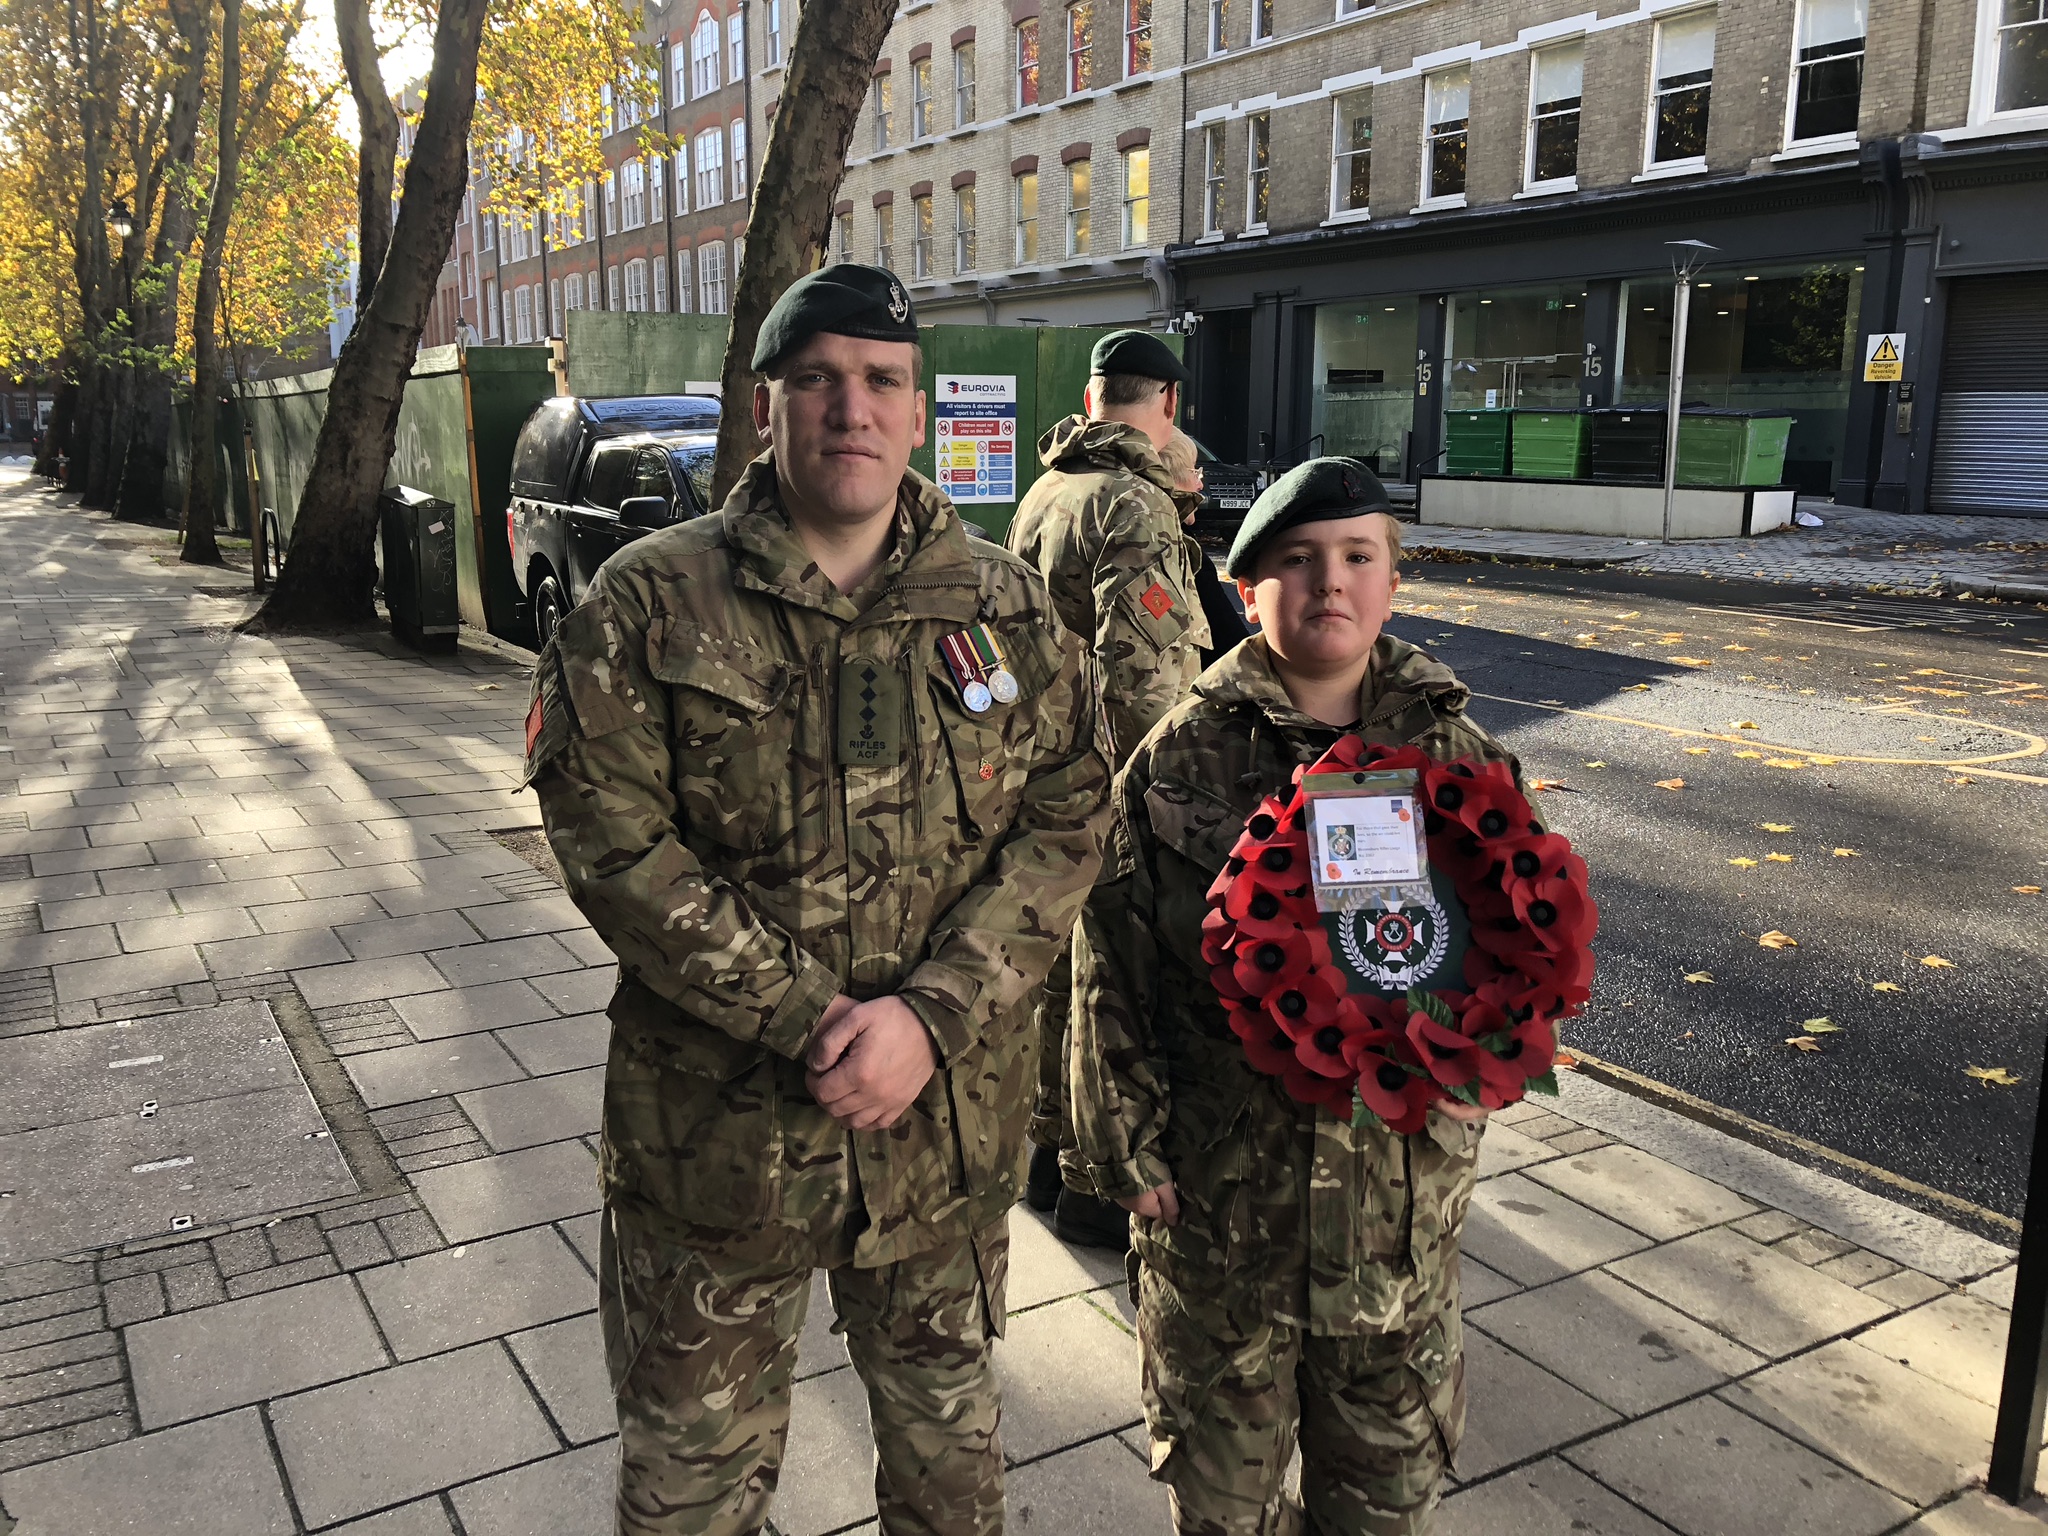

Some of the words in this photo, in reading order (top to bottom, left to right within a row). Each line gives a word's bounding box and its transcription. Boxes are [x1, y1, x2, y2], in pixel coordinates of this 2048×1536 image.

[1582, 356, 1602, 377] 15
[1416, 363, 1432, 382] 15
[600, 402, 717, 412] TRUCKMAN
[849, 740, 886, 749] RIFLES
[857, 751, 879, 759] ACF
[1364, 867, 1410, 875] Remembrance
